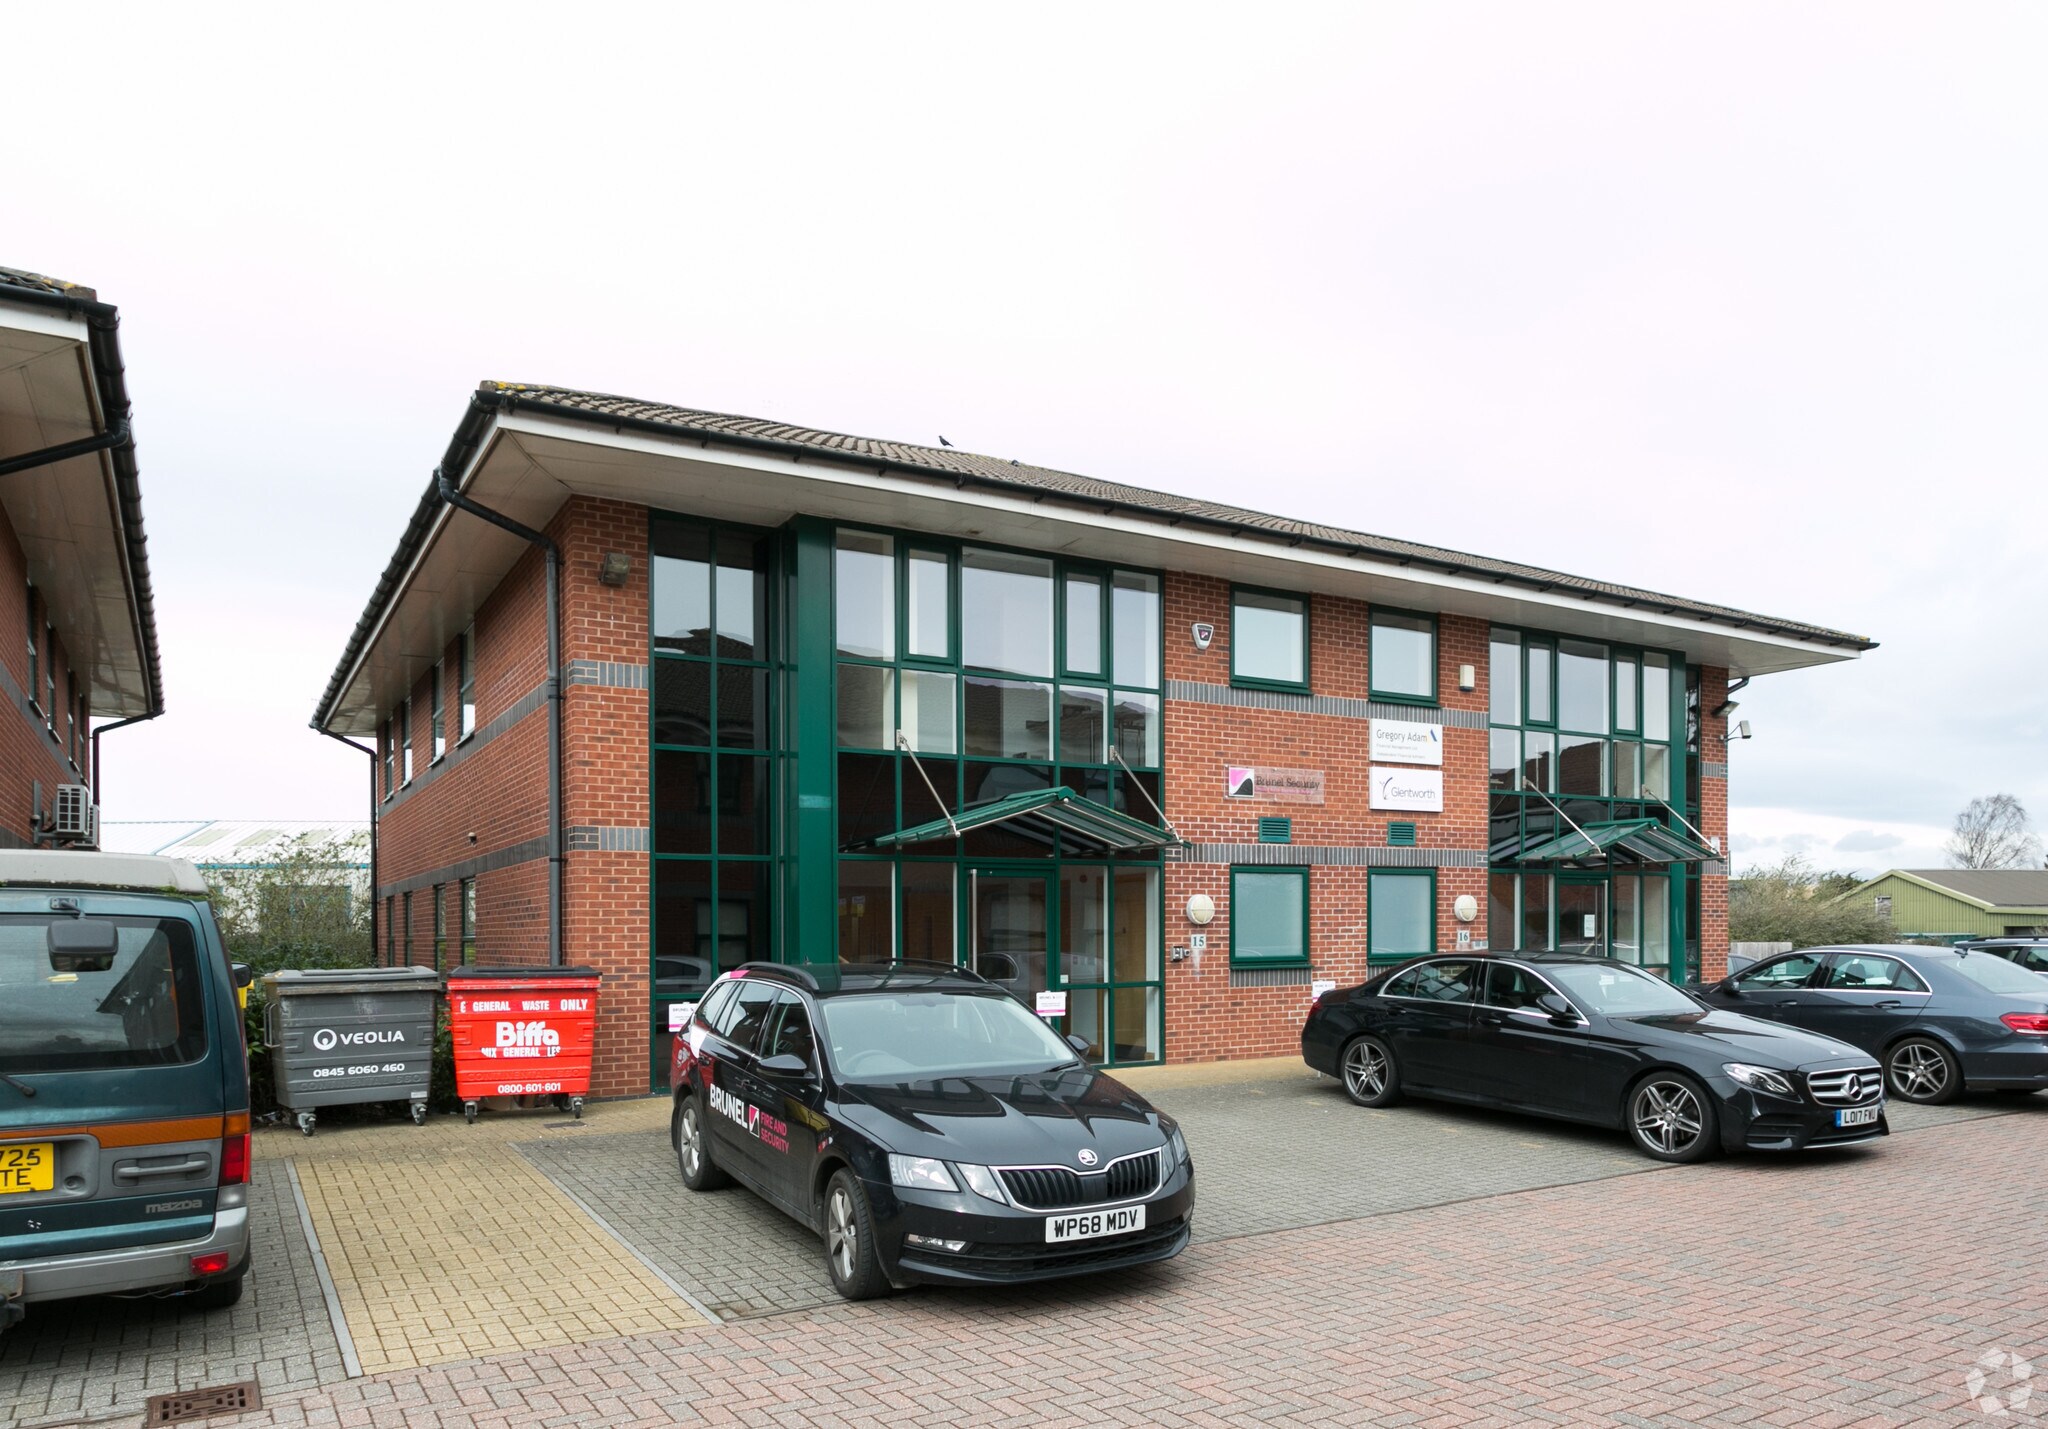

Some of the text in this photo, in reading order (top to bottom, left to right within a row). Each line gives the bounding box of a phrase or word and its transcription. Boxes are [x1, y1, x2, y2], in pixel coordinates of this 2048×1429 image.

[1376, 729, 1428, 742] Gregory Adam
[1256, 776, 1320, 790] Brunel Security
[1391, 787, 1436, 799] Glentworth
[1192, 936, 1204, 947] 15
[1459, 932, 1469, 942] 16
[472, 1001, 510, 1012] GENERAL
[522, 1000, 550, 1010] WASTE
[560, 999, 588, 1010] ONLY
[340, 1030, 405, 1045] VEOLIA
[496, 1022, 559, 1047] Biffa
[503, 1047, 540, 1058] GENERAL
[313, 1063, 405, 1078] 0845 6060 460
[498, 1083, 561, 1094] 0800-601-601
[710, 1083, 748, 1129] BRUNEL
[760, 1112, 788, 1137] FIRE AND
[760, 1128, 790, 1154] SECURITY
[145, 1199, 203, 1214] mazda
[1054, 1209, 1138, 1238] WP68 MDV
